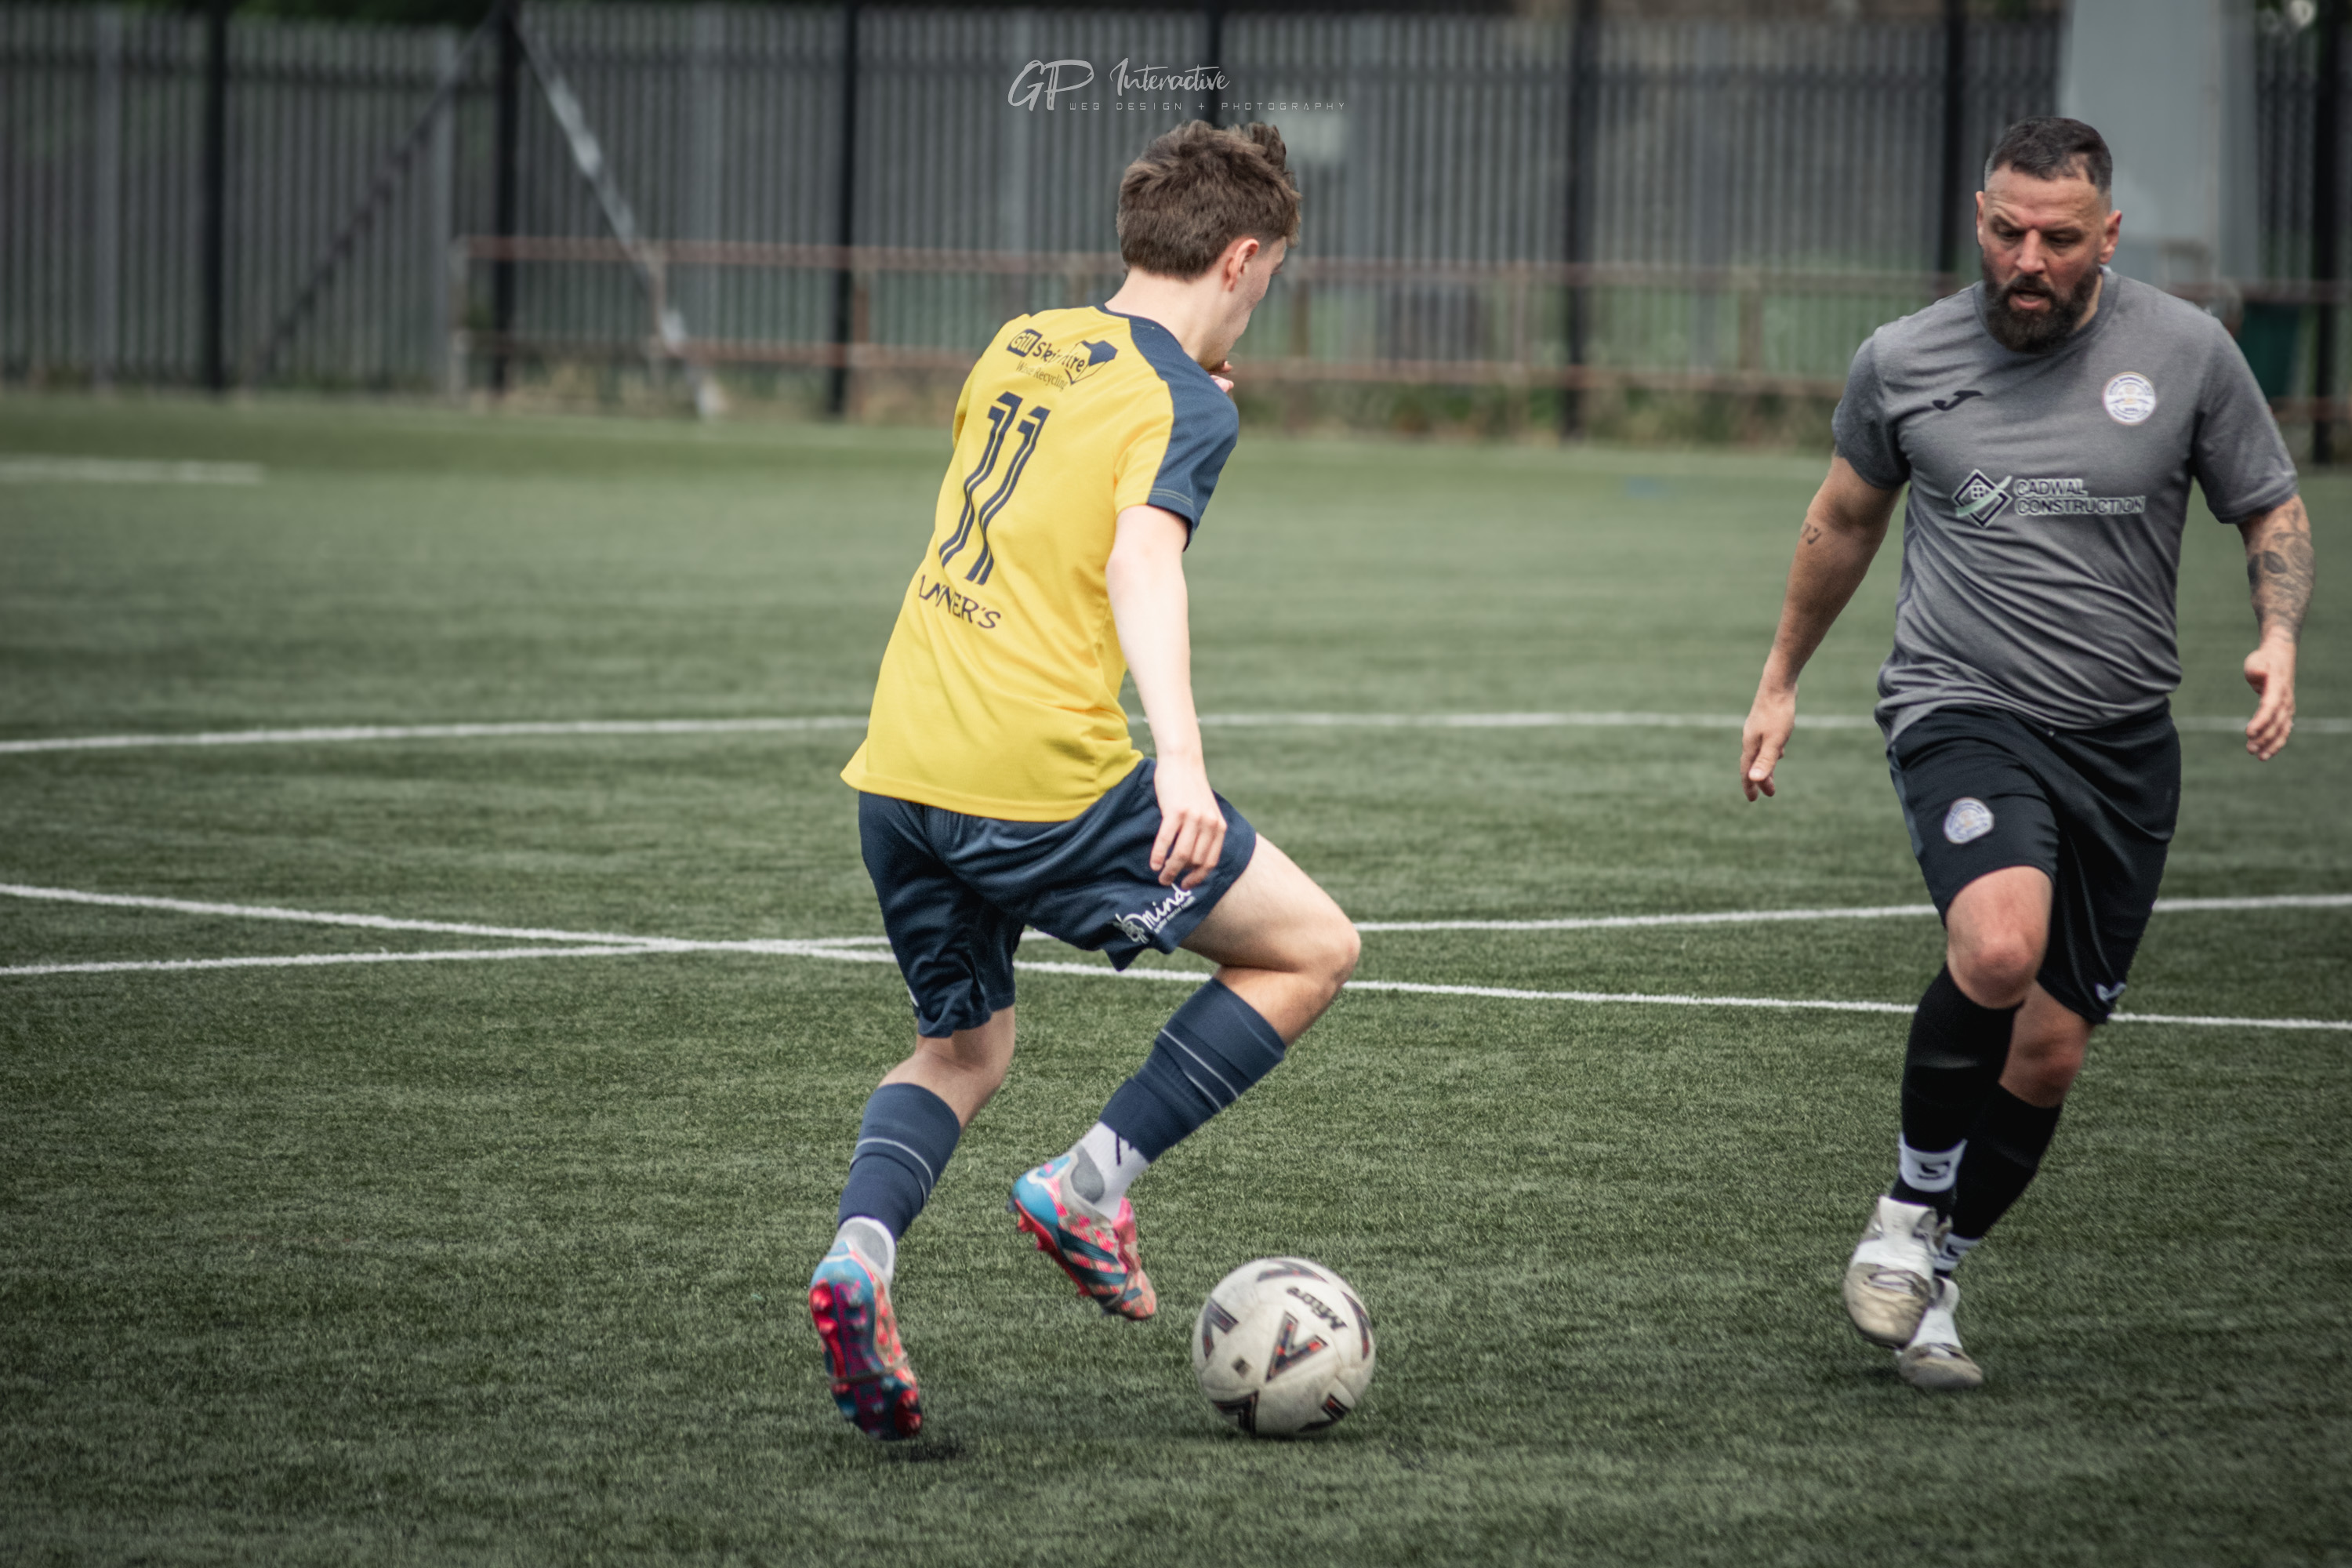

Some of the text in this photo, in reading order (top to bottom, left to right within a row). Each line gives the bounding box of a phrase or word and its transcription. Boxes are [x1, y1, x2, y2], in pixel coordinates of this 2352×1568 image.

[1011, 332, 1038, 354] Gill
[1034, 367, 1068, 391] Recycling
[938, 390, 1051, 586] 11
[2014, 479, 2089, 497] CADWAL
[2015, 496, 2146, 516] CONSTRUCTION
